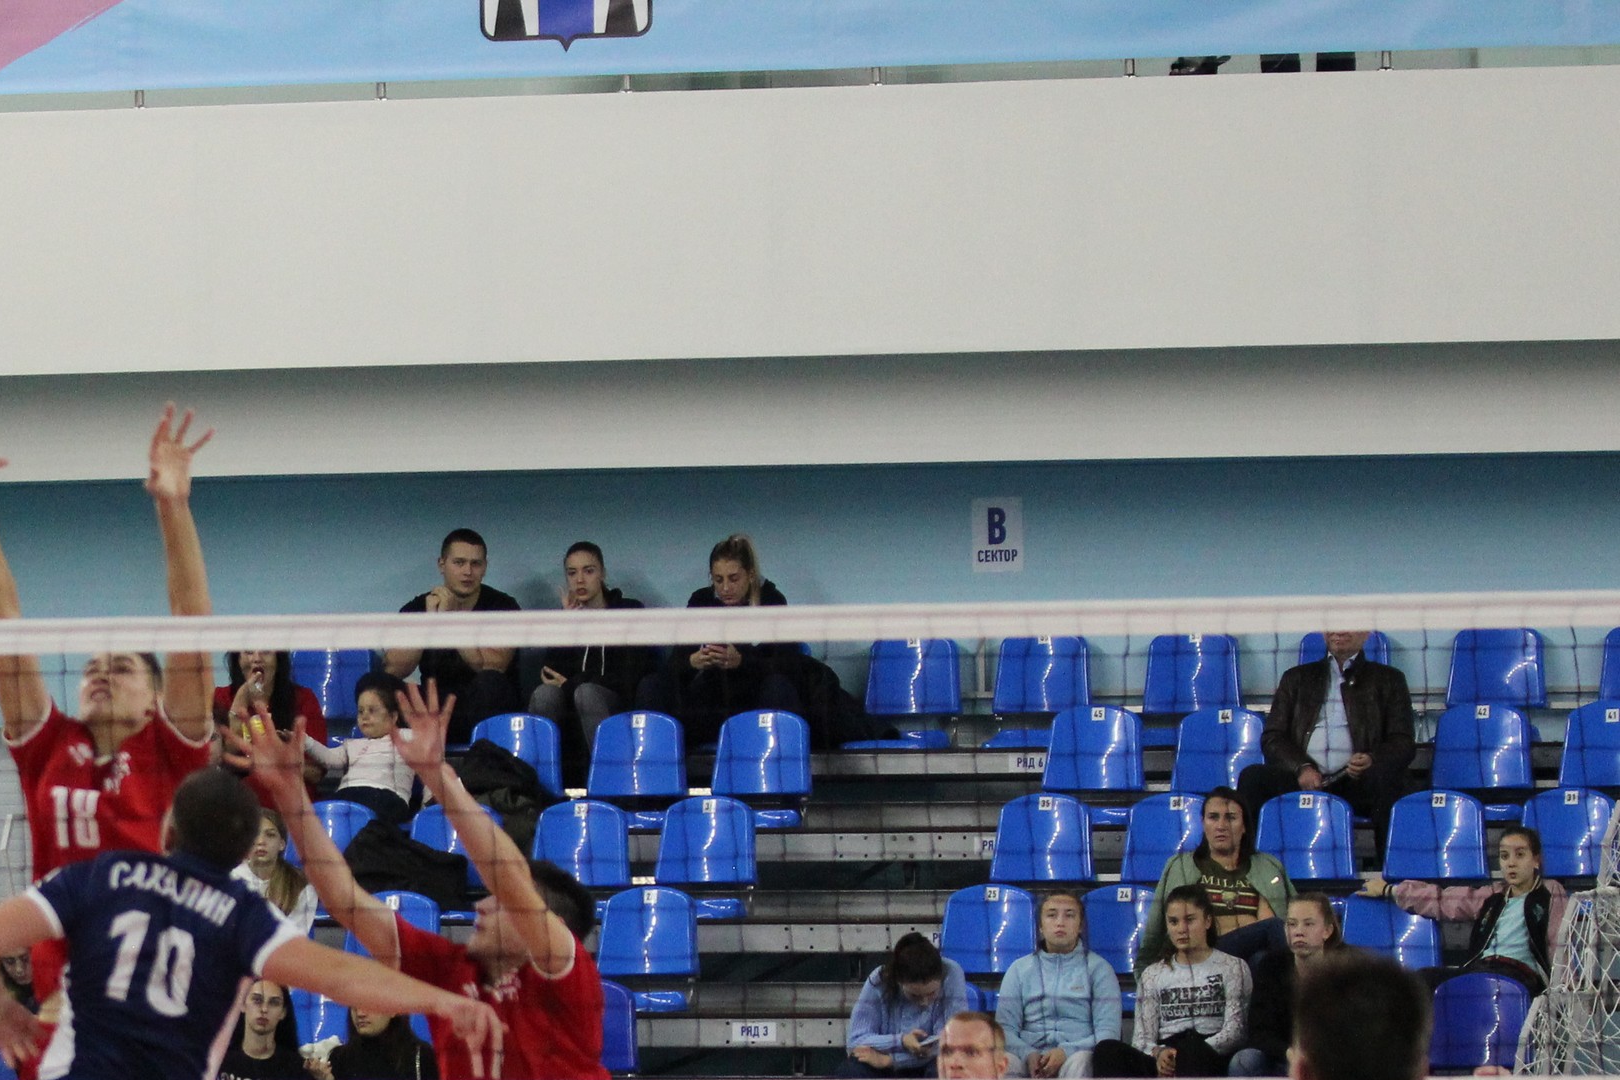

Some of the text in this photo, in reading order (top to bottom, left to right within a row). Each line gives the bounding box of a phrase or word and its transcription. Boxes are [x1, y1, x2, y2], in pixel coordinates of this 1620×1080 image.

[977, 548, 1018, 563] СЕКТОР
[1092, 708, 1104, 720] 45
[1220, 710, 1231, 720] 44
[1477, 707, 1489, 717] 42
[1606, 710, 1618, 720] 41
[1016, 757, 1044, 769] РЯД 6
[1300, 796, 1311, 807] 33
[1433, 795, 1445, 805] 32
[1565, 792, 1577, 802] 31
[1040, 798, 1052, 809] 35
[982, 840, 994, 850] РЯ
[987, 889, 998, 899] 25
[1119, 889, 1130, 899] 24
[105, 909, 196, 1017] 10
[740, 1025, 769, 1038] РЯД 3
